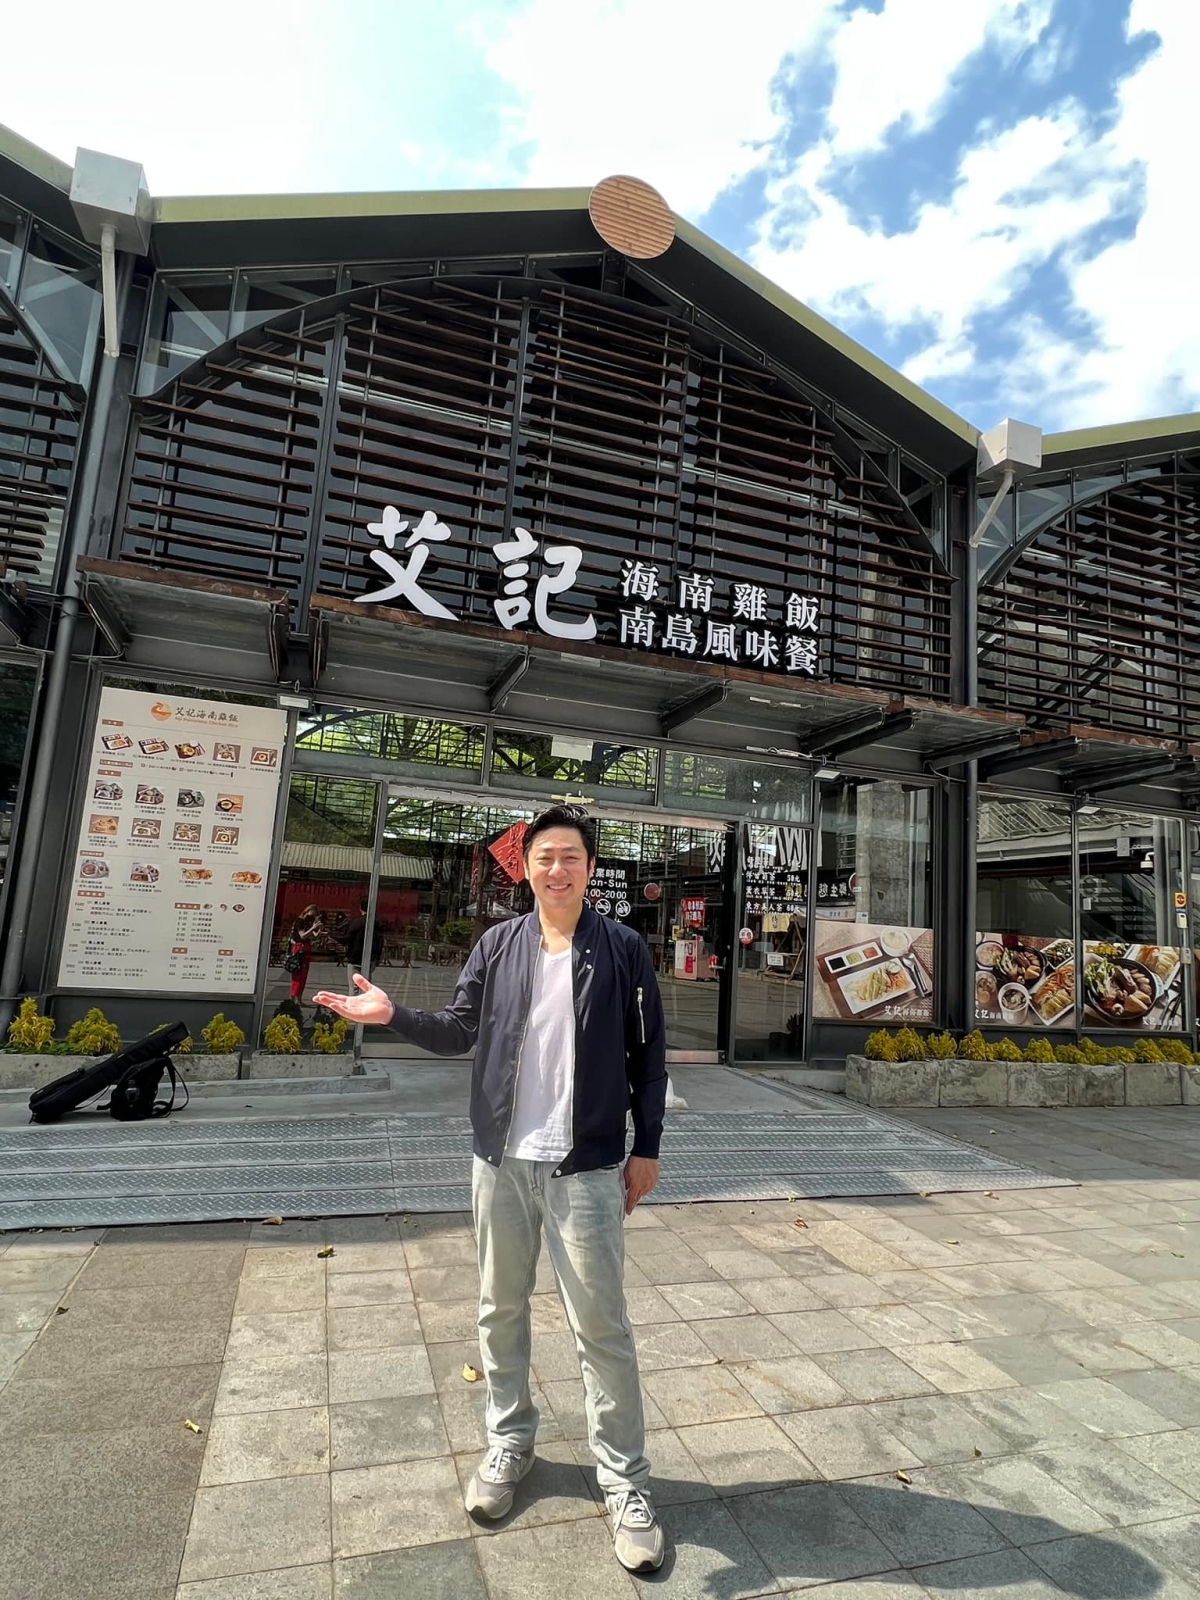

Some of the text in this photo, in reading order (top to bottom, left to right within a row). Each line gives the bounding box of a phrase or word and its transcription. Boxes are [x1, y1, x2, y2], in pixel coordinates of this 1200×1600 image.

[353, 505, 598, 641] 艾記
[620, 557, 820, 633] 海南雞飯
[619, 606, 819, 676] 南島風味餐
